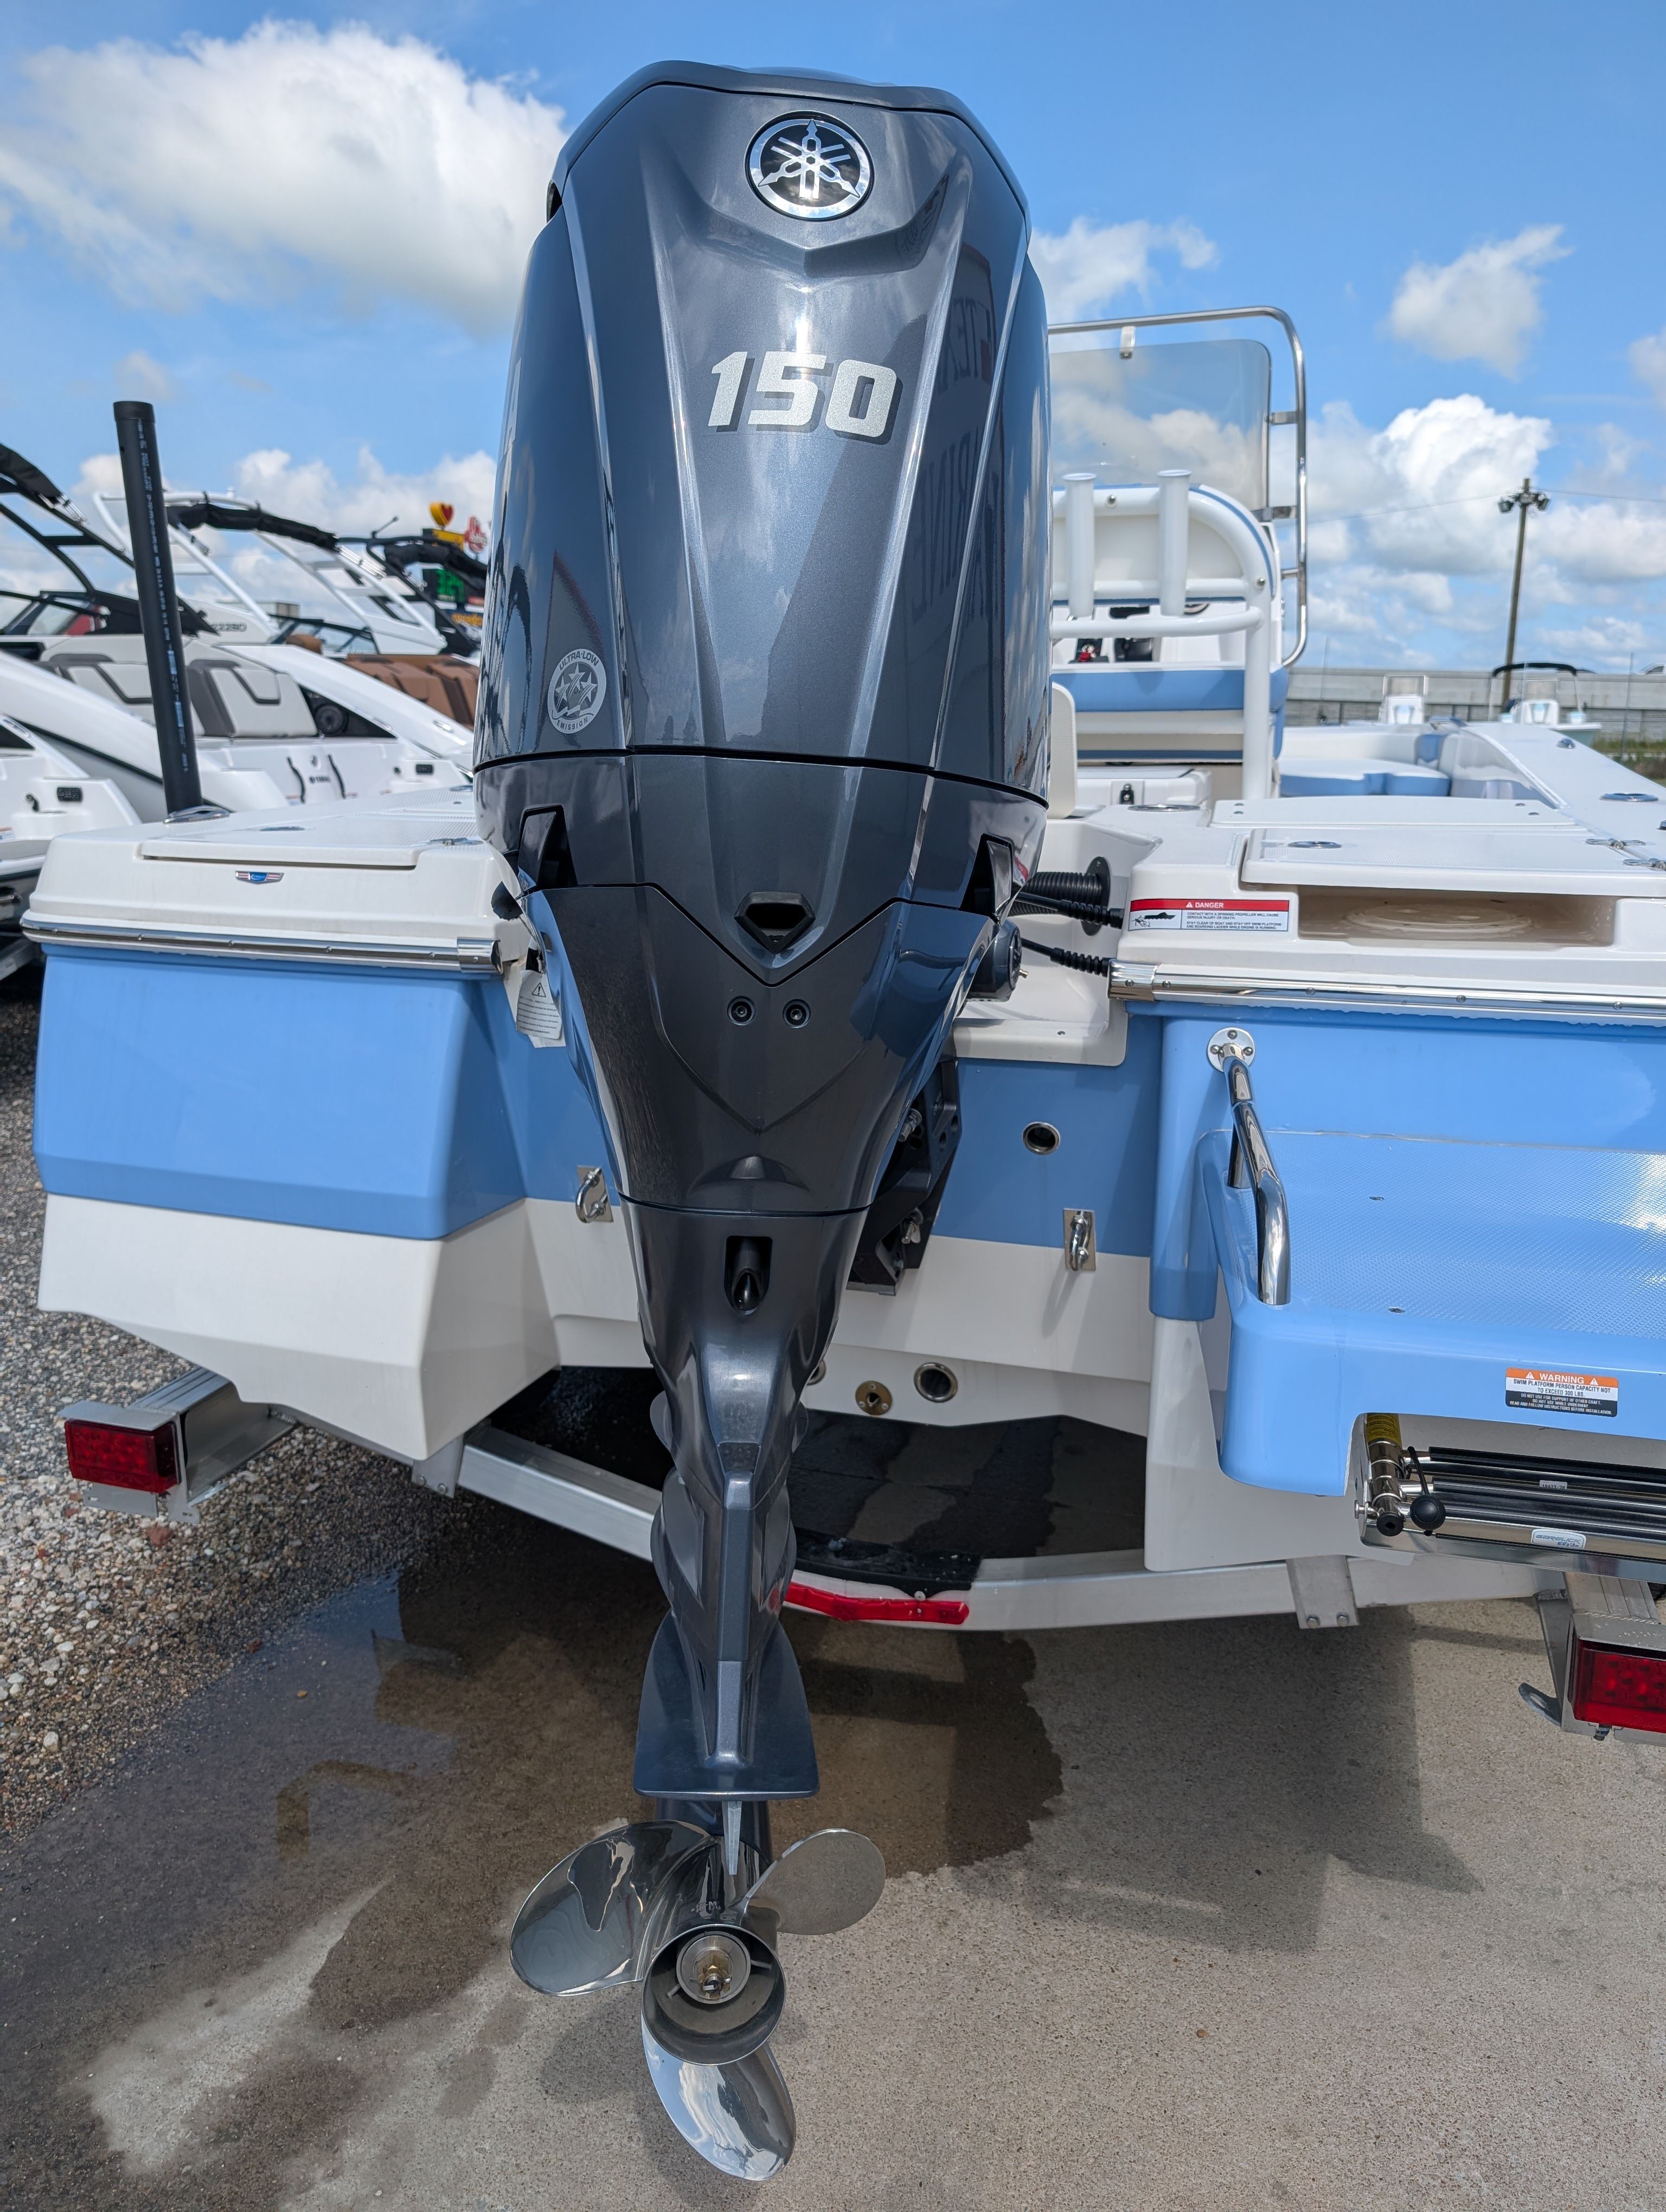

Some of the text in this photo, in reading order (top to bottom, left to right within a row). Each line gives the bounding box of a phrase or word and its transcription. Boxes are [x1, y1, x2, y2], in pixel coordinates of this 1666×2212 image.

[708, 351, 900, 443] 150
[556, 717, 588, 730] EMISSION
[1539, 1373, 1584, 1384] WARNING
[1535, 1534, 1582, 1544] GARELICK
